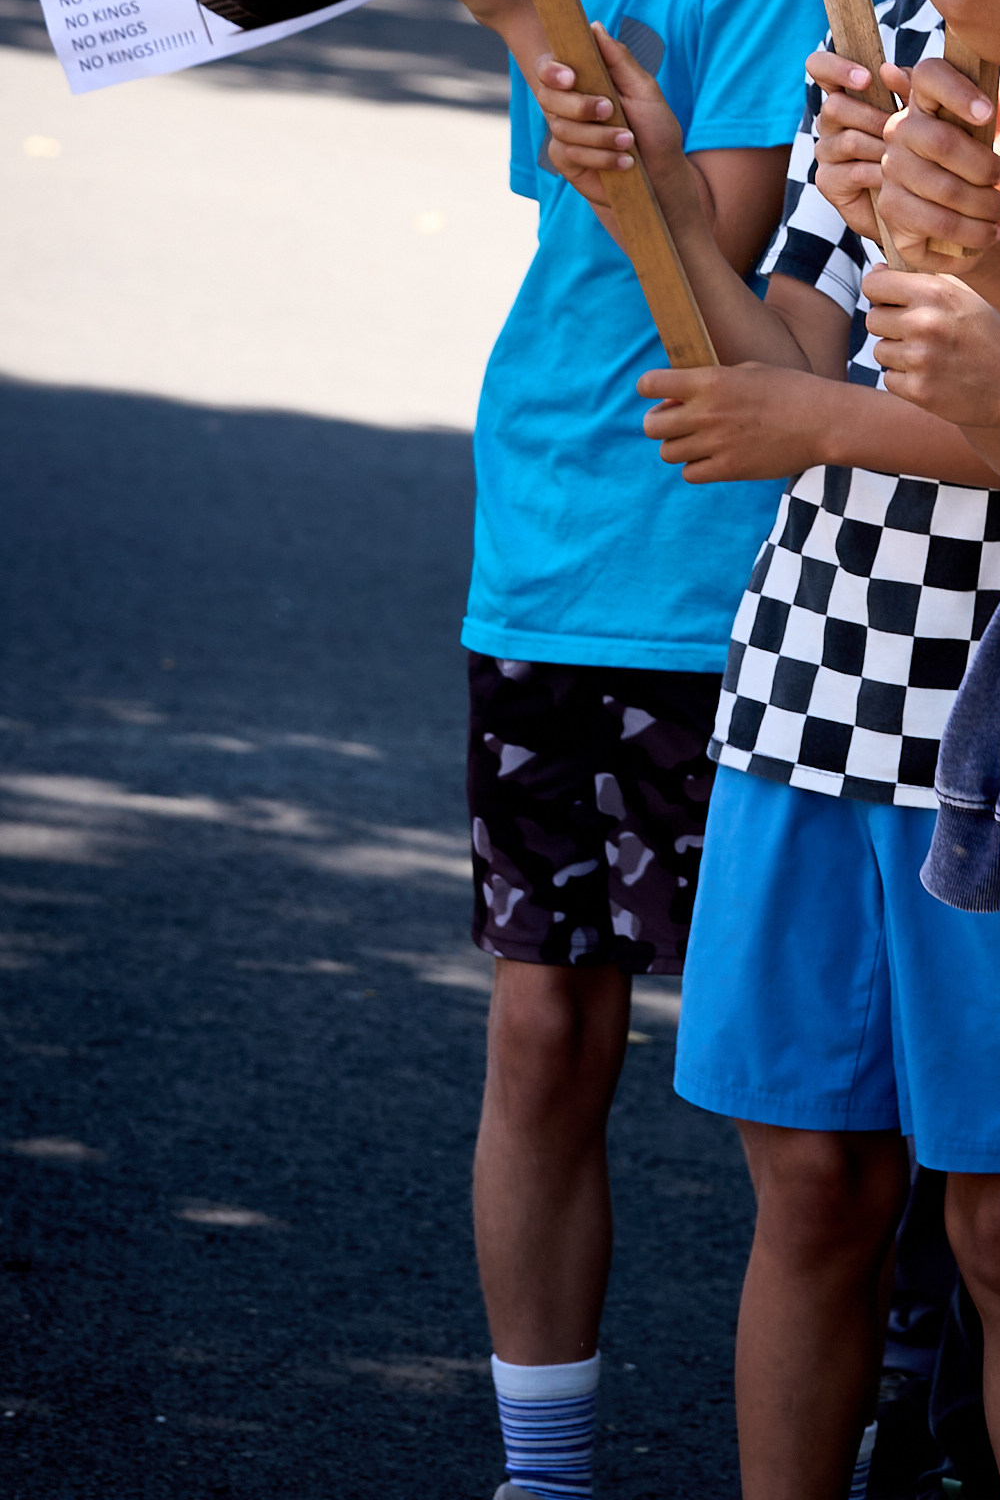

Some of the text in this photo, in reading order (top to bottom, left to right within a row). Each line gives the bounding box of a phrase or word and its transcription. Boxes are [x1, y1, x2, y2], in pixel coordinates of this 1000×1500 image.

[65, 0, 141, 30] NO KINGS
[72, 21, 148, 51] NO KINGS
[79, 30, 197, 73] NO KINGS!!!!!!!
